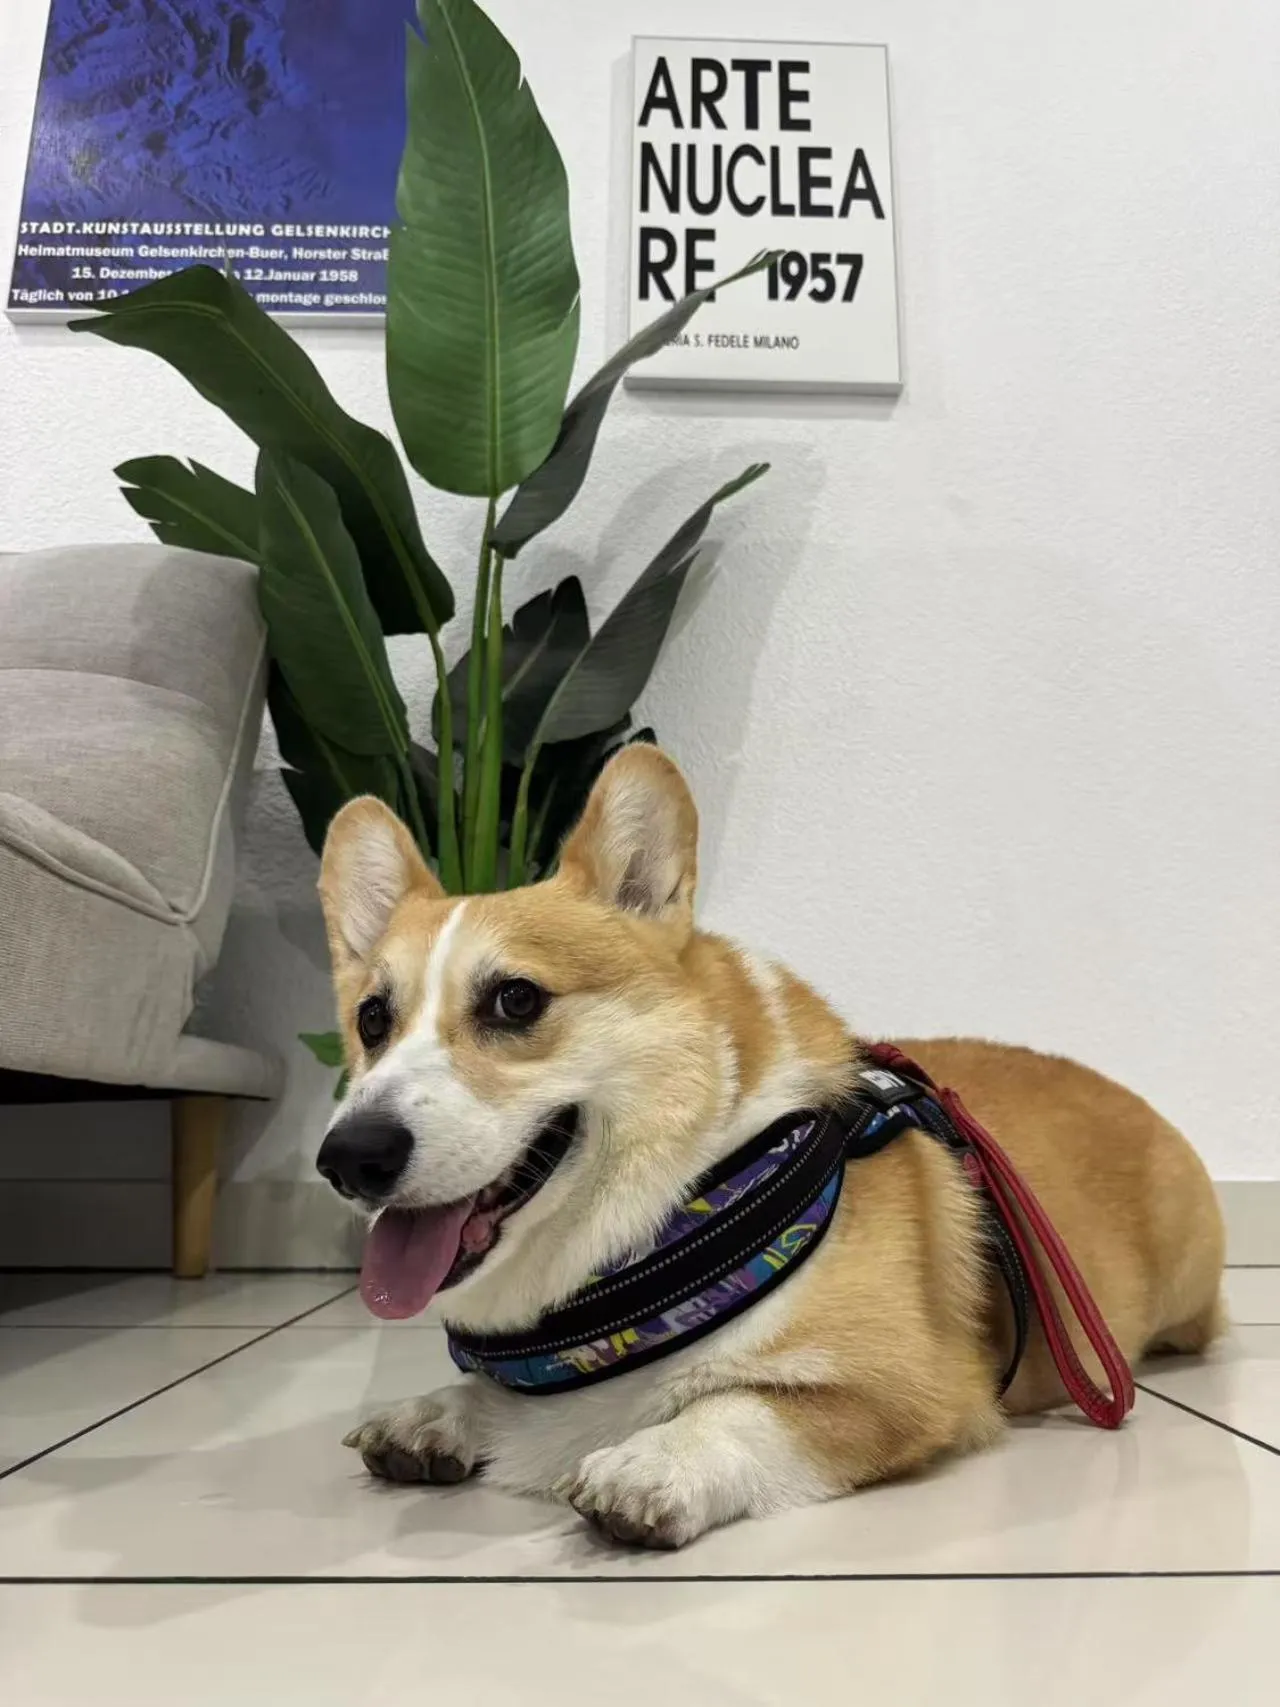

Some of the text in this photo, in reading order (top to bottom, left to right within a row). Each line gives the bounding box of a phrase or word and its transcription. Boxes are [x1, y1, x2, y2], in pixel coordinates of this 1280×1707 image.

[638, 56, 811, 131] ARTE
[639, 141, 886, 219] NUCLEA
[20, 222, 265, 237] STADT.KUNSTAUSSTELLUNG
[17, 245, 133, 258] Heimatmuseum
[138, 245, 289, 260] Gelsenkirchen-Buer,
[292, 247, 348, 260] Horster
[638, 226, 863, 303] RE 1957
[71, 267, 96, 280] 15.
[244, 268, 315, 282] 12.Januar
[319, 270, 359, 282] 1958
[12, 288, 64, 304] Täglich
[67, 291, 94, 301] von
[256, 292, 321, 306] montage
[707, 333, 750, 349] FEDELE
[753, 334, 801, 350] MILANO
